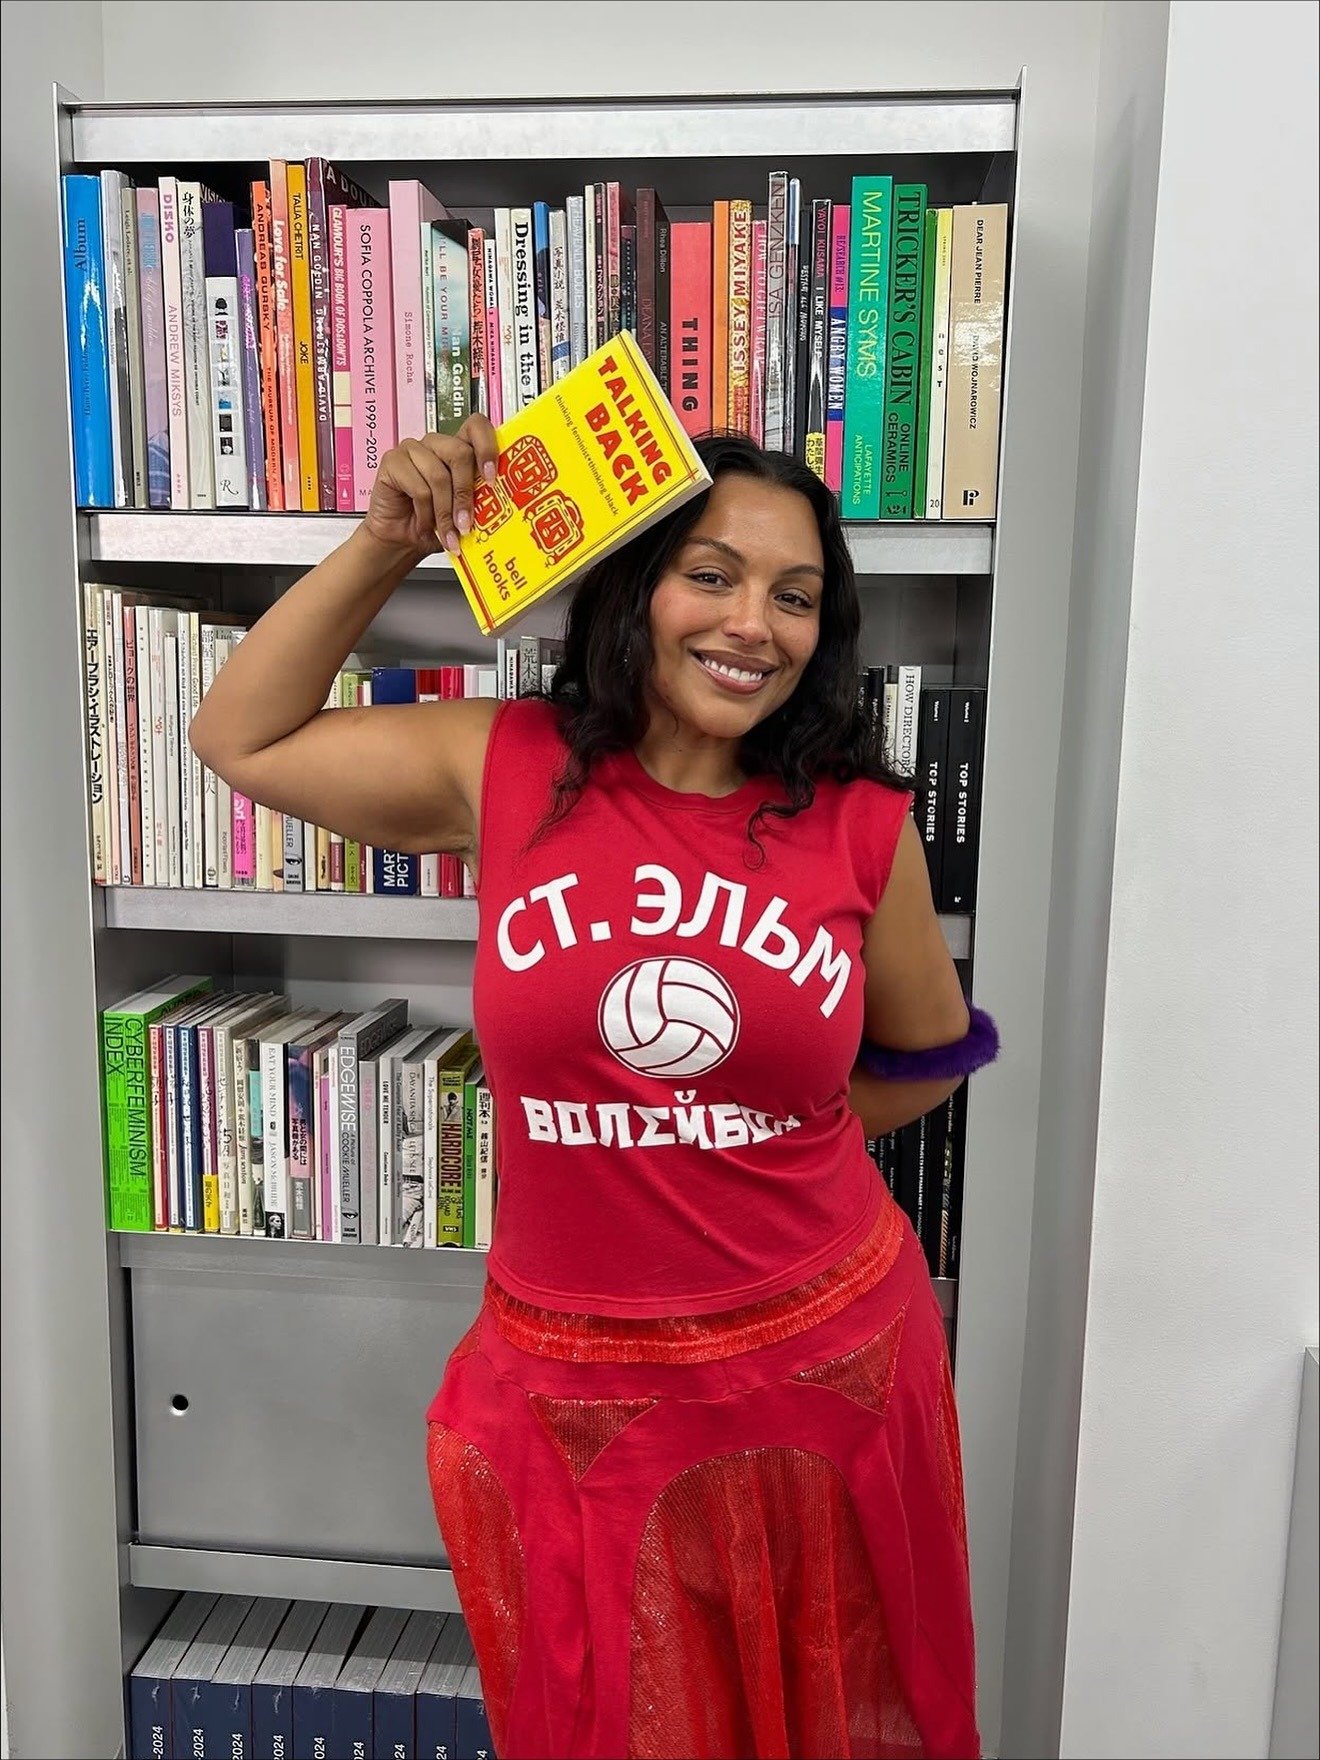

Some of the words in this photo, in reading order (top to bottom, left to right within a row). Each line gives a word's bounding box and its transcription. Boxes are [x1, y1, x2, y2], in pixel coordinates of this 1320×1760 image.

[163, 194, 174, 244] DISKO
[182, 191, 196, 240] 身体の夢
[292, 192, 302, 220] TALIA
[817, 208, 826, 234] YAYOI
[73, 219, 88, 272] Album
[257, 204, 268, 270] ANDREAS
[274, 220, 286, 254] Love
[294, 222, 304, 260] CHETRIT
[312, 224, 321, 250] NAN
[333, 208, 344, 267] GLAMOUR'S
[360, 224, 372, 265] SOFIA
[572, 211, 581, 264] HEAVENLY
[756, 234, 766, 261] HOW
[769, 182, 785, 279] GENZKEN
[859, 191, 883, 302] MARTINE
[976, 220, 984, 244] DEAR
[275, 256, 288, 278] for
[440, 266, 448, 282] BE
[514, 222, 530, 317] Dressing
[733, 212, 747, 300] MIYAKE
[816, 239, 826, 278] KUSAMA
[836, 235, 846, 275] RE/SEARCH
[975, 246, 984, 270] JEAN
[313, 255, 322, 299] GOLDIN
[334, 268, 345, 282] BIG
[335, 282, 346, 305] BOOK
[574, 269, 583, 308] BODIES
[756, 270, 766, 286] TO
[974, 272, 982, 304] PIERRE
[261, 276, 270, 330] GURSKY
[276, 280, 290, 312] Sale
[336, 306, 346, 316] OF
[362, 270, 374, 333] COPPOLA
[440, 286, 448, 321] YOUR
[768, 287, 784, 319] ISA
[815, 296, 824, 316] LIKE
[168, 305, 180, 364] ANDREW
[404, 312, 413, 348] Simone
[519, 326, 533, 346] in
[642, 298, 652, 338] DEANA
[660, 322, 667, 334] AN
[300, 340, 308, 364] JOKE
[732, 306, 746, 372] ISSEY
[814, 320, 824, 358] MYSELF
[830, 318, 846, 358] ANGRY
[856, 308, 880, 378] SYMS
[364, 336, 376, 394] ARCHIVE
[406, 354, 414, 384] Rocha
[521, 352, 534, 386] the
[682, 318, 698, 412] THING
[890, 331, 916, 406] CABIN
[170, 369, 182, 416] MIKSYS
[452, 363, 464, 418] Goldin
[828, 366, 844, 410] WOMEN
[968, 363, 979, 430] WOJNAROWICZ
[270, 424, 274, 435] OF
[597, 355, 673, 486] TALKING
[554, 394, 574, 427] thinking
[604, 493, 618, 516] black
[585, 402, 649, 507] BACK
[886, 412, 898, 483] CERAMICS
[898, 422, 910, 472] ONLINE
[852, 434, 862, 505] ANTICIPATIONS
[863, 444, 873, 495] LAFAYETTE
[930, 499, 940, 508] 20
[482, 550, 511, 600] hooks
[505, 556, 528, 591] bell
[904, 674, 914, 702] HOW
[928, 762, 938, 786] TOP
[959, 762, 969, 788] TOP
[926, 790, 937, 842] STORIES
[956, 792, 968, 844] STORIES
[383, 850, 396, 887] MAR
[397, 852, 409, 888] PICT
[496, 871, 613, 974] СТ.
[629, 863, 853, 1020] ЭЛЬМ
[104, 1016, 125, 1076] INDEX
[268, 1048, 276, 1066] EAT
[125, 1018, 147, 1176] CYBERFEMINISM
[268, 1066, 276, 1091] YOUR
[340, 1046, 356, 1132] EDGEWISE
[383, 1095, 389, 1103] ME
[479, 1092, 491, 1118] 週刊本
[342, 1132, 350, 1164] COOKIE
[441, 1124, 462, 1187] HARDCORE
[342, 1164, 351, 1203] MUELLER
